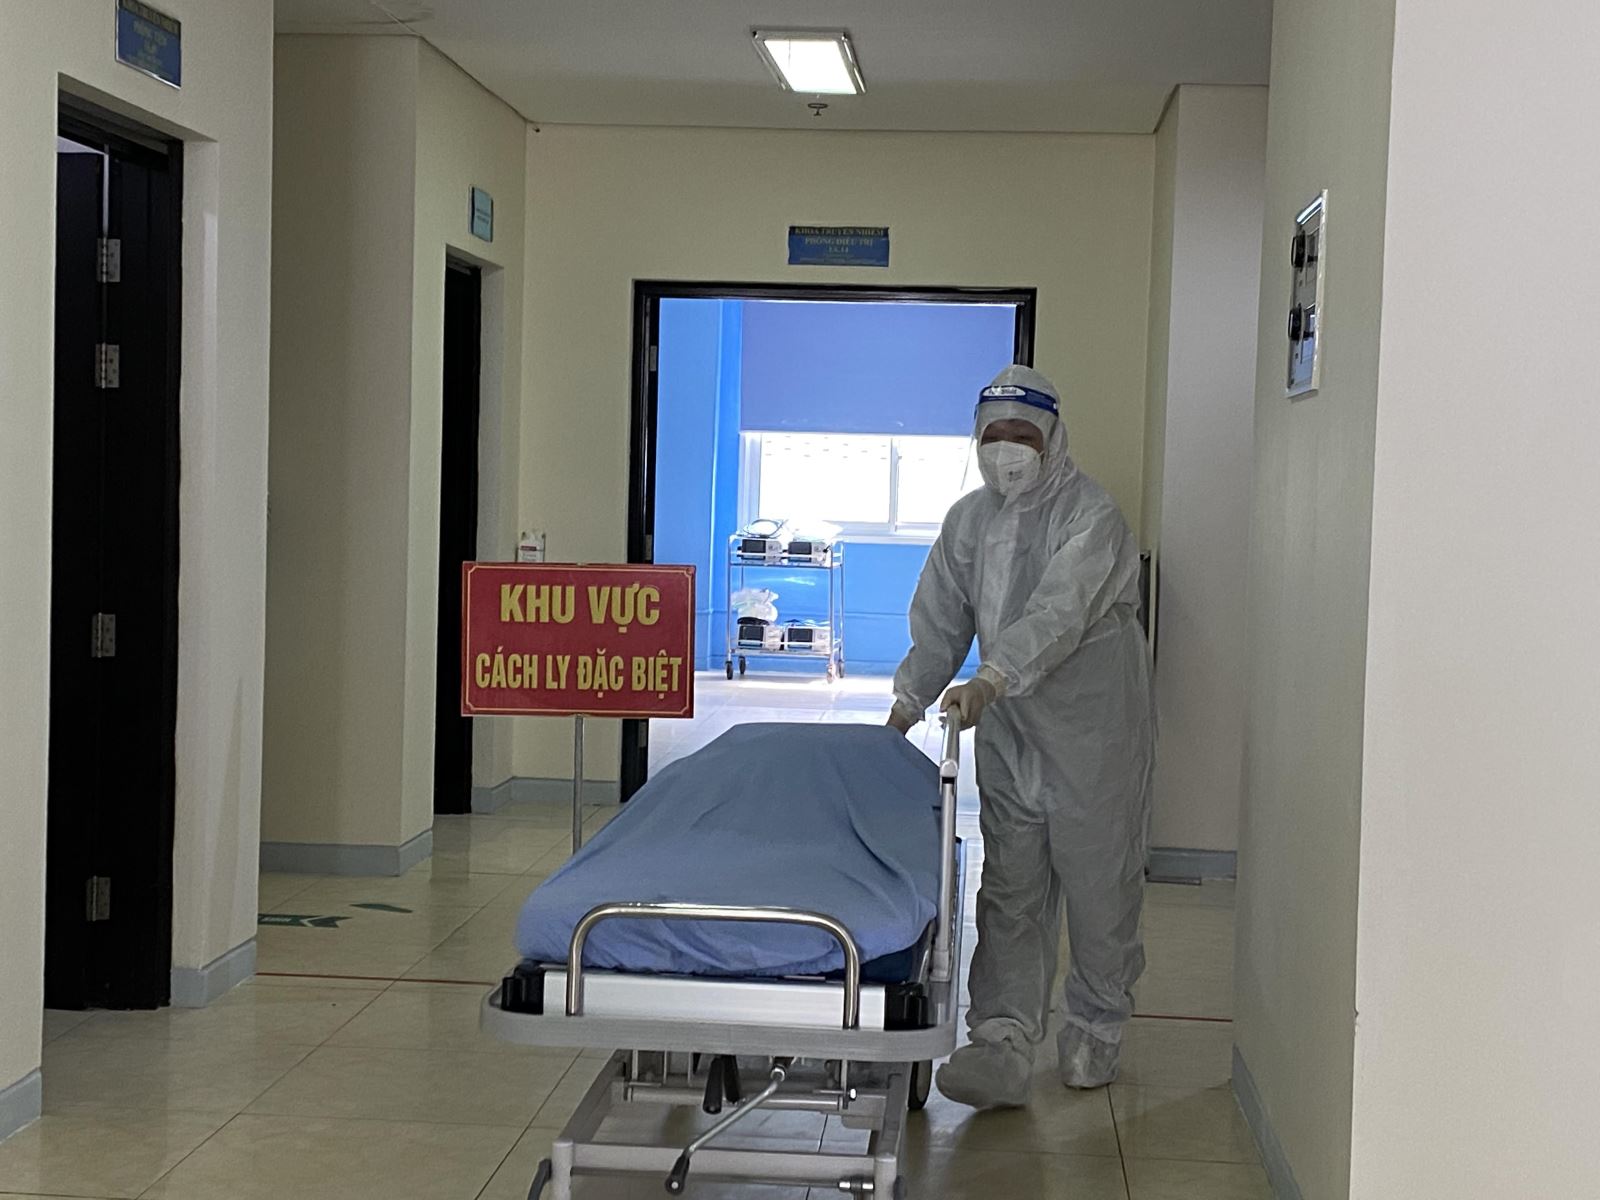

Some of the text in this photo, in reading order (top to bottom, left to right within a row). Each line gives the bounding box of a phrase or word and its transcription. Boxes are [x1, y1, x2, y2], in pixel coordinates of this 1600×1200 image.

[500, 583, 660, 633] KHU VỰC
[475, 646, 682, 699] CÁCH LY ĐẶC BIỆT
